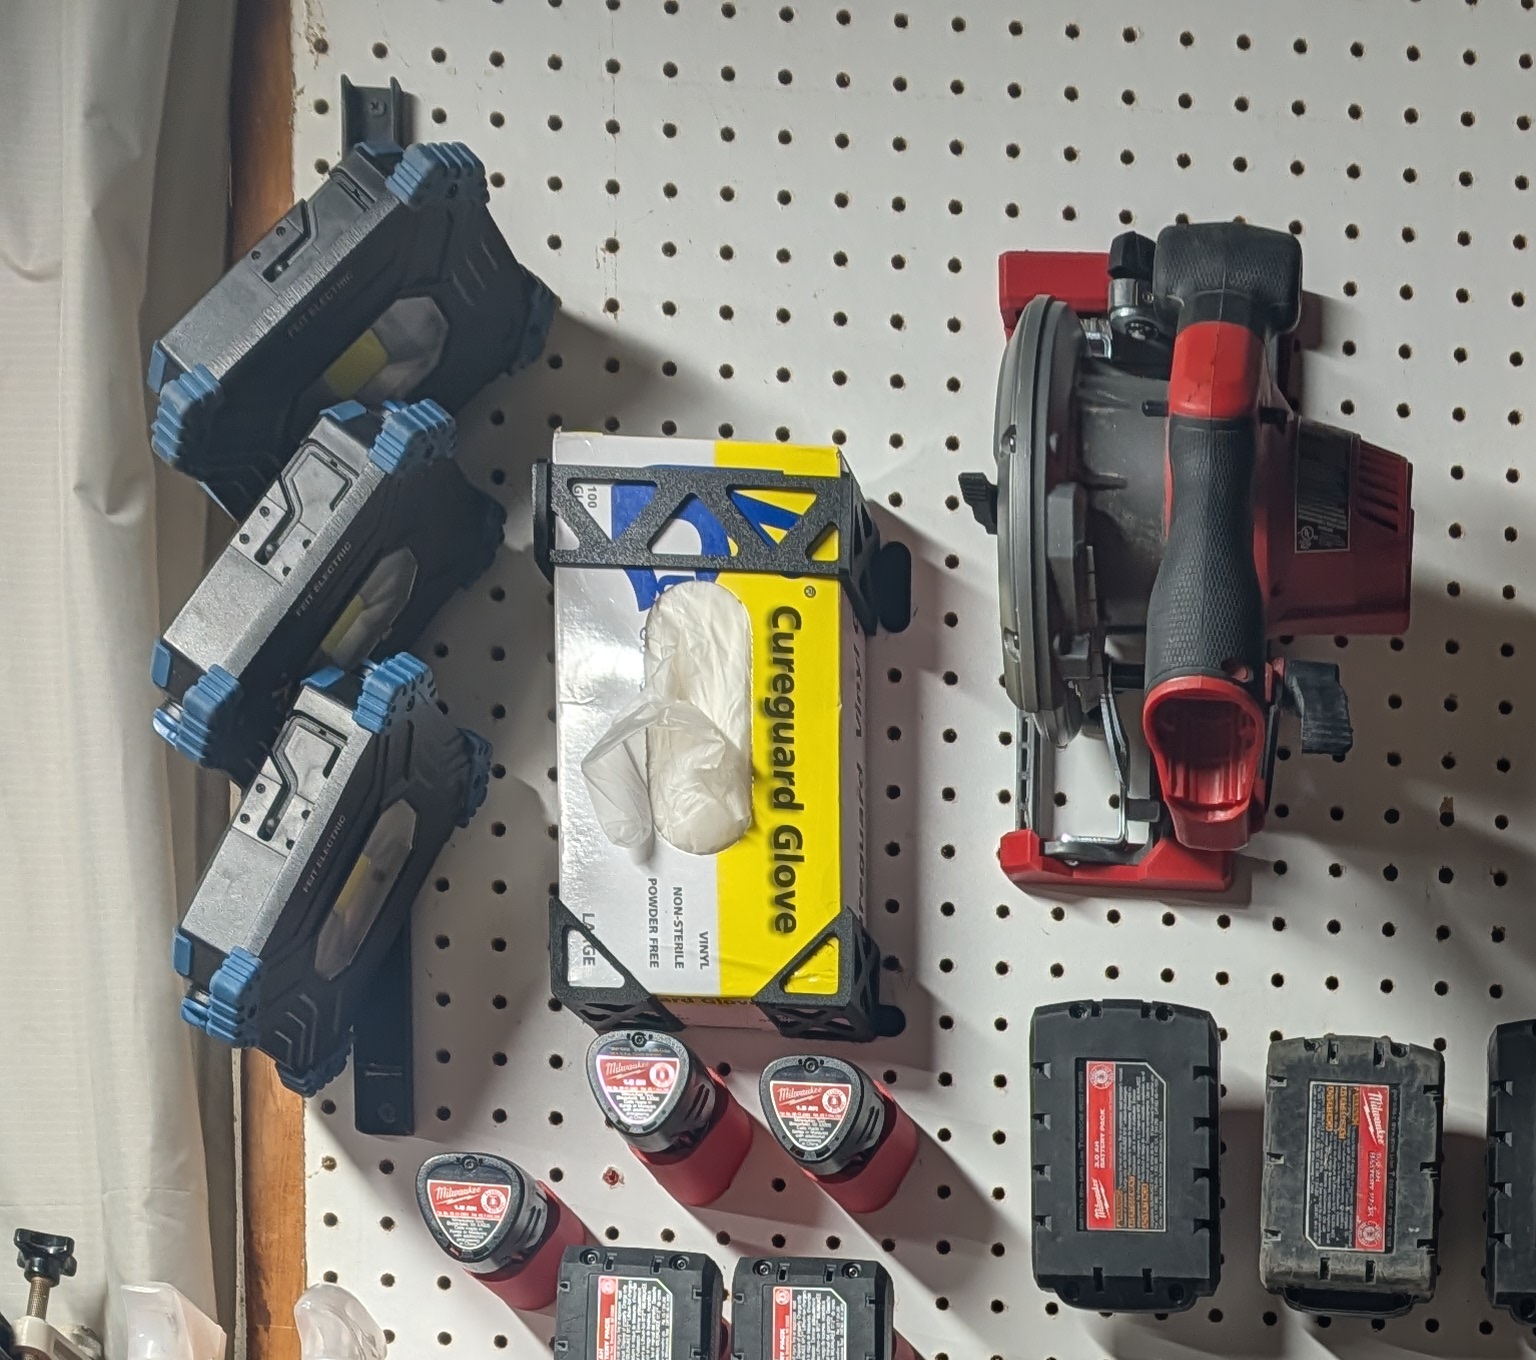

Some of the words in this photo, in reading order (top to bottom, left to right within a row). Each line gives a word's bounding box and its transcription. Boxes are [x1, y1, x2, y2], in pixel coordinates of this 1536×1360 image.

[588, 486, 597, 509] 100
[764, 606, 804, 811] Cureguard
[773, 825, 805, 935] Glove
[648, 877, 658, 934] POWDER
[582, 912, 596, 966] LAGE
[673, 886, 684, 969] NON-STERILE
[649, 937, 659, 969] FREE
[699, 931, 709, 970] VINYL
[605, 1061, 650, 1077] Milwaukee
[777, 1086, 823, 1102] Milwaukee
[1368, 1090, 1385, 1147] Milwaukee
[434, 1186, 482, 1201] Milwaukee
[1091, 1178, 1107, 1220] Milwaukee
